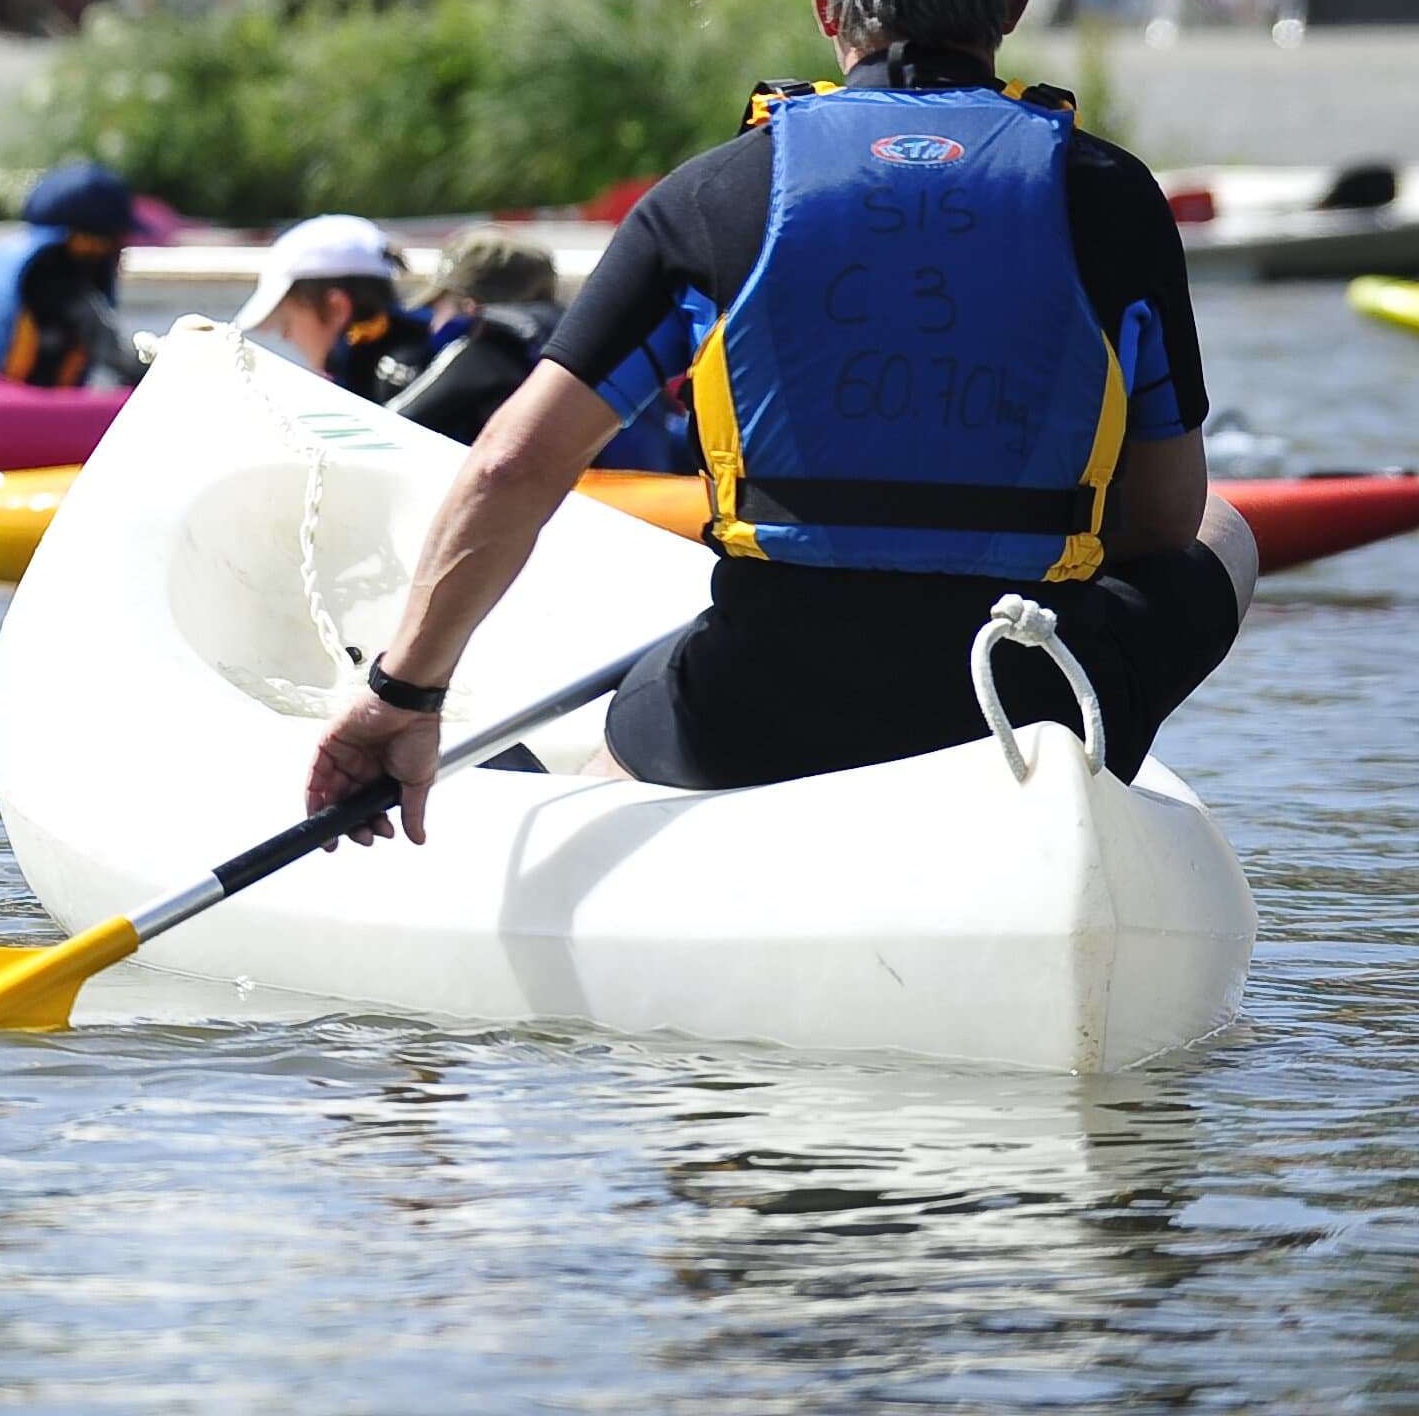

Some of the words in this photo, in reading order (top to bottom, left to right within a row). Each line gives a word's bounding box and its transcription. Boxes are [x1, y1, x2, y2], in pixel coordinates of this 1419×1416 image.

[863, 187, 976, 233] SIS
[827, 264, 869, 323] C
[913, 267, 956, 333] 3
